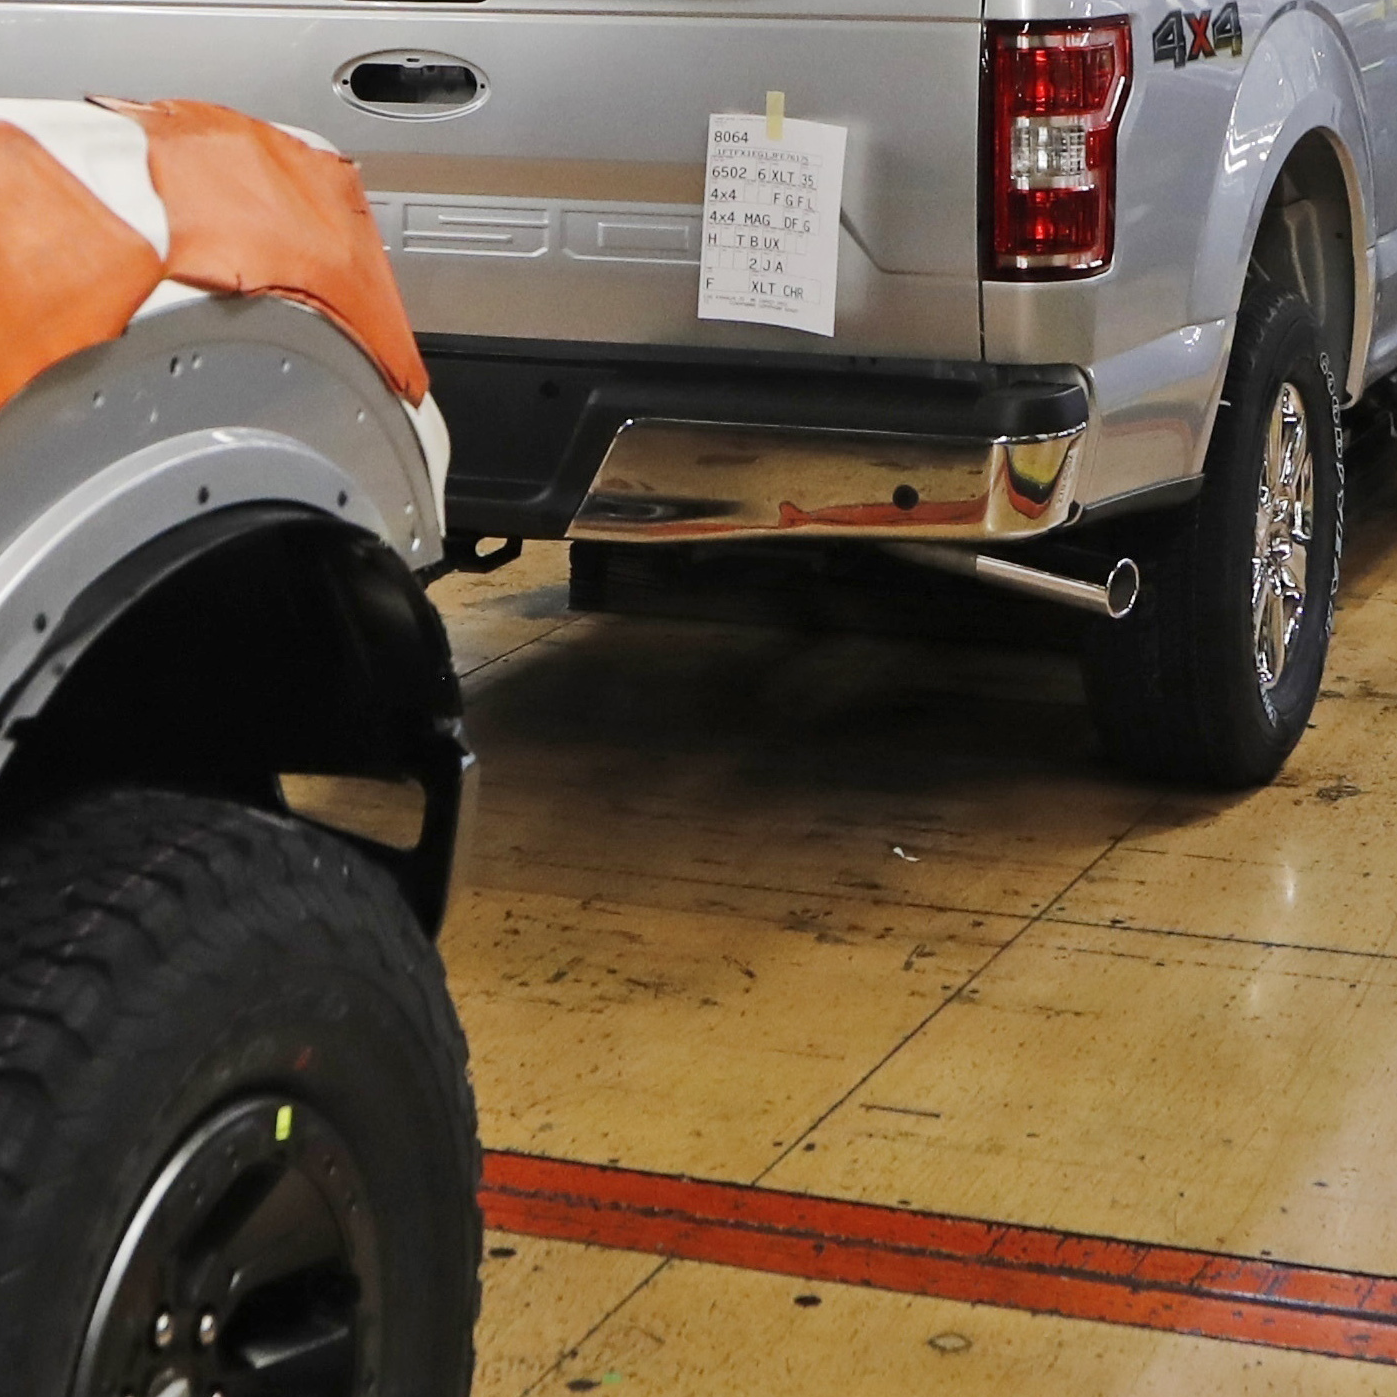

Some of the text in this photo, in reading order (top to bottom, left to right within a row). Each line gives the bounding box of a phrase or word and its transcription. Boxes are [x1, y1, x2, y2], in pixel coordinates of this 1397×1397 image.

[713, 130, 750, 144] 8064
[711, 165, 748, 180] 6502
[771, 169, 796, 184] XLT
[743, 213, 772, 227] MAG
[751, 280, 777, 295] XLT
[782, 284, 805, 299] CHR
[1318, 351, 1345, 638] GOODYEAR
